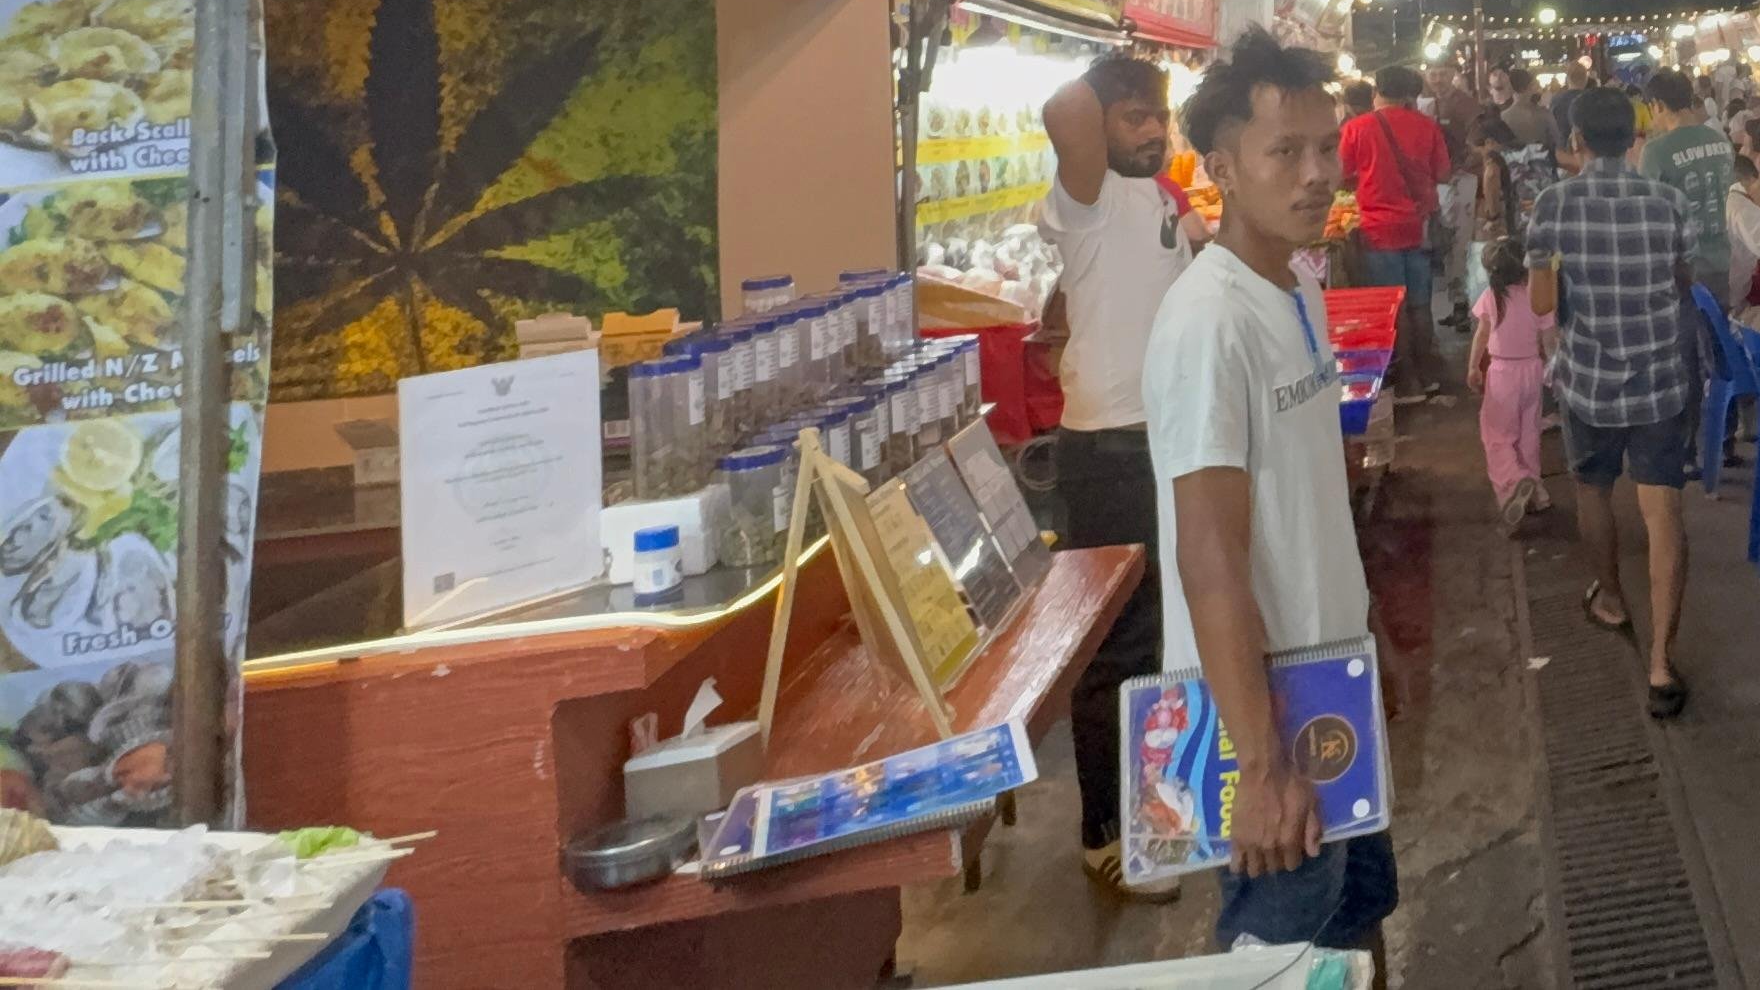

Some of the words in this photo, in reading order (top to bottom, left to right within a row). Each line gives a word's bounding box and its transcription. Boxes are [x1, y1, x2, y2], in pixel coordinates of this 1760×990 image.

[136, 118, 190, 139] Scall
[70, 151, 127, 174] with
[1672, 146, 1704, 166] SLOW
[13, 359, 96, 387] Grilled
[105, 352, 159, 380] N/Z
[61, 387, 114, 411] with
[64, 626, 137, 656] Fresh
